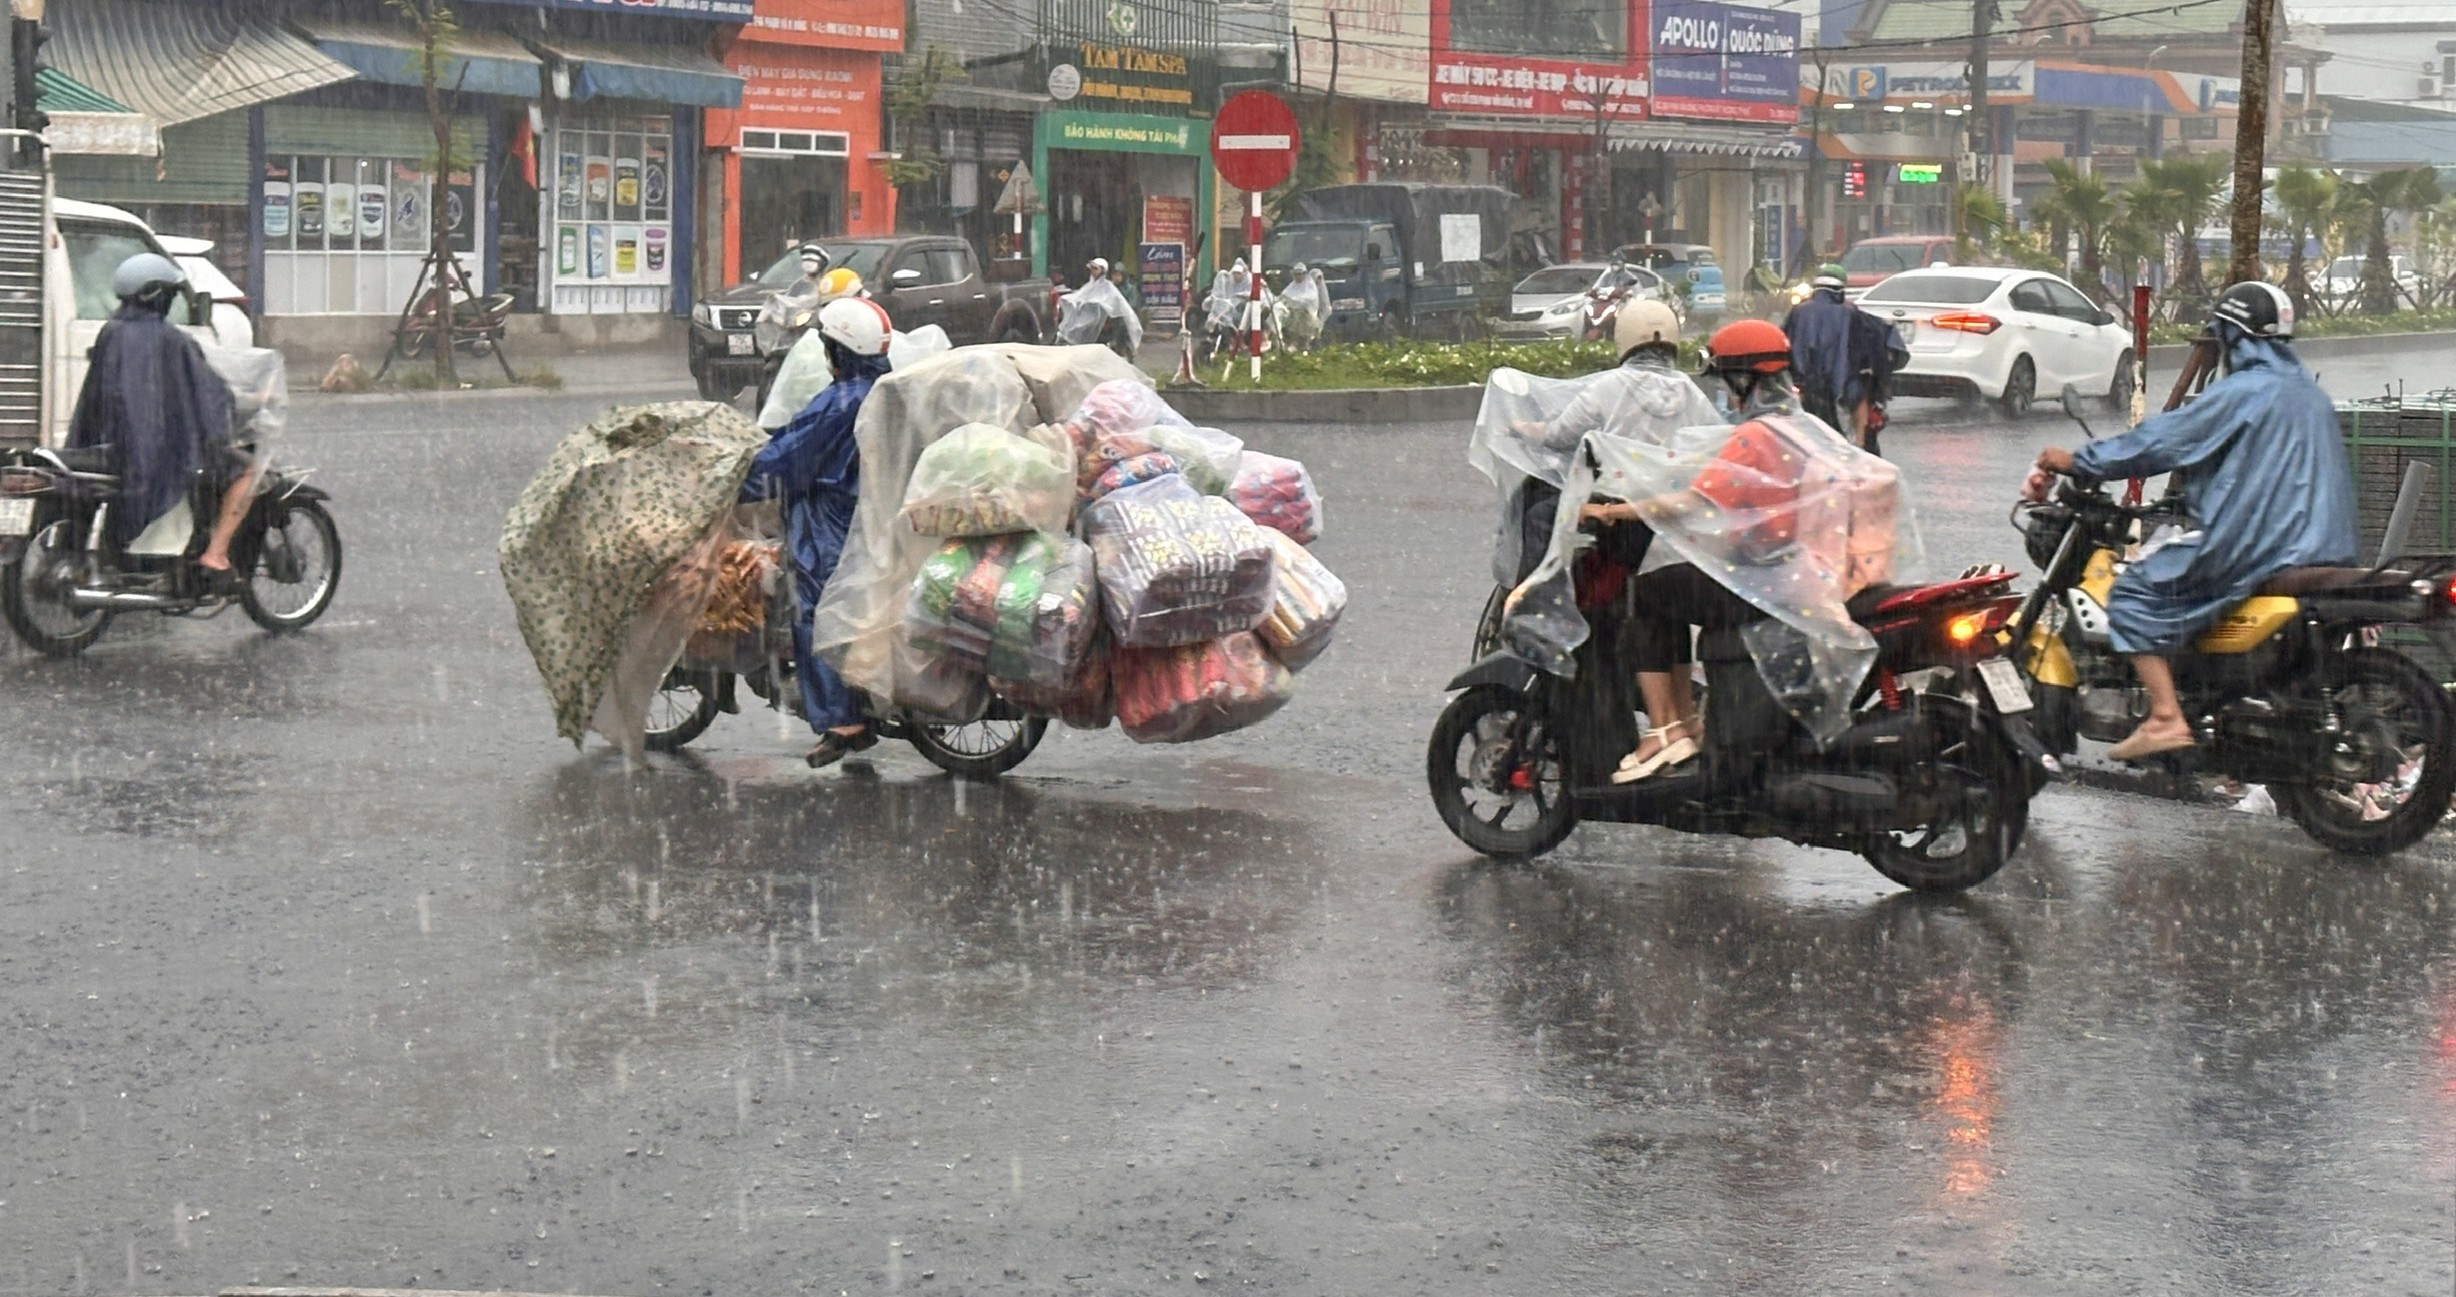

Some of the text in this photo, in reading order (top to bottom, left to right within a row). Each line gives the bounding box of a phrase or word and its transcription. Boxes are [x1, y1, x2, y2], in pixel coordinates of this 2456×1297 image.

[1660, 16, 1718, 49] APOLLO
[1729, 23, 1762, 53] QUỐC
[1064, 122, 1084, 138] BẢO
[1085, 124, 1113, 140] HÀNH
[1114, 127, 1147, 142] KHÔNG
